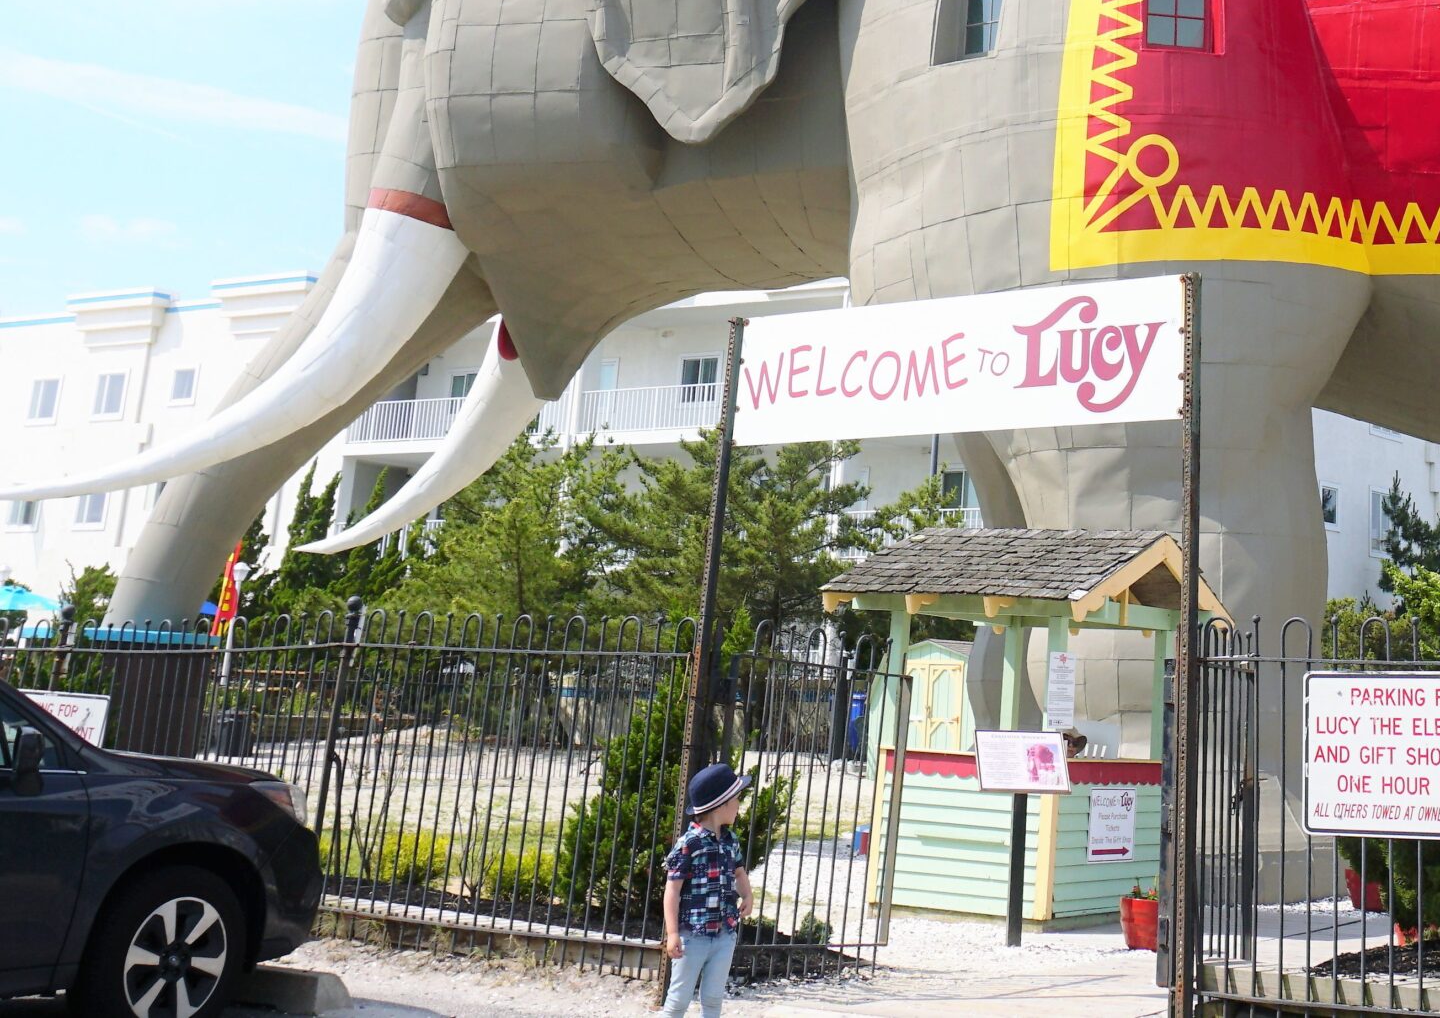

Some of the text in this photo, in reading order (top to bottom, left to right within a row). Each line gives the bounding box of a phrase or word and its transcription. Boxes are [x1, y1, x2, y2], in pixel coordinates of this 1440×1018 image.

[745, 295, 1167, 413] WELCOME TO Lucy
[1351, 688, 1425, 706] PARKING
[1316, 716, 1360, 734] LUCY
[1370, 717, 1402, 735] THE
[1314, 746, 1349, 763] AND
[1360, 747, 1396, 764] GIFT
[1337, 775, 1371, 793] ONE
[1382, 777, 1429, 795] HOUR
[1314, 803, 1329, 817] ALL
[1334, 804, 1368, 819] OTHERS
[1372, 805, 1400, 820] TOWED
[1404, 806, 1414, 820] AT
